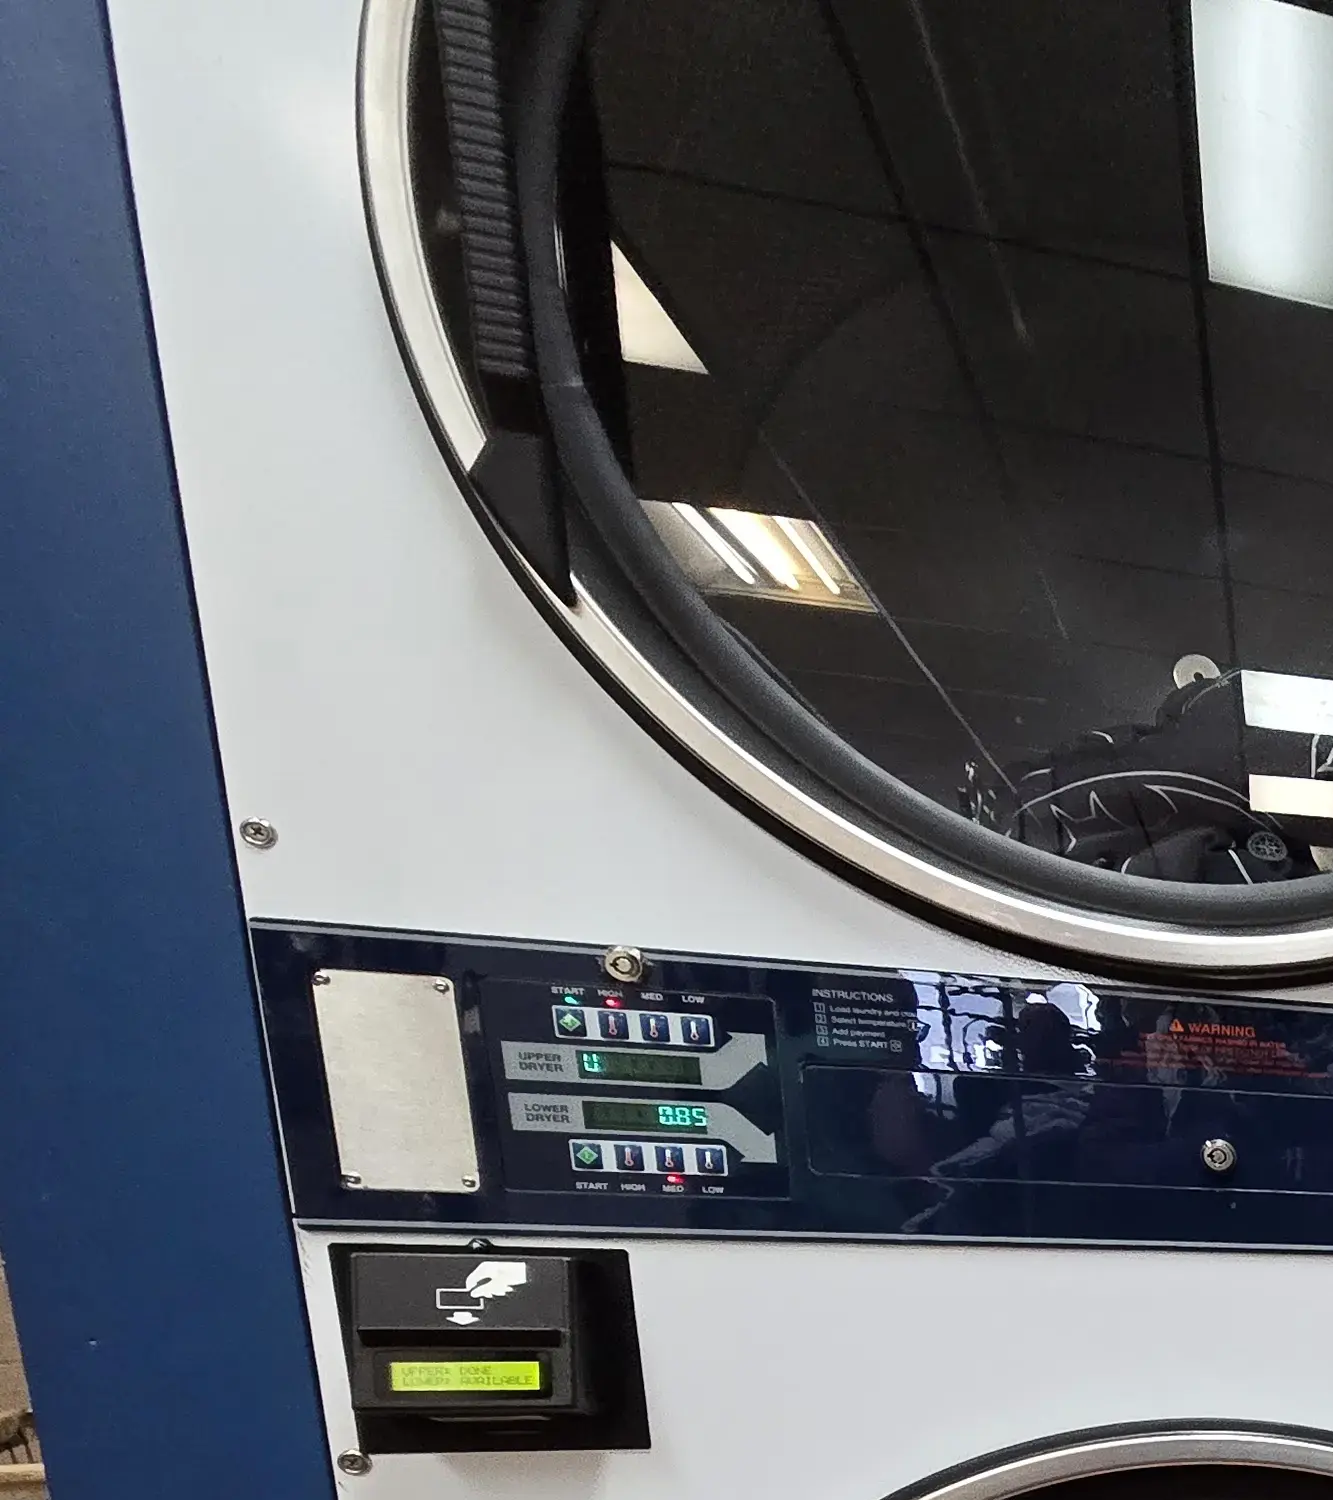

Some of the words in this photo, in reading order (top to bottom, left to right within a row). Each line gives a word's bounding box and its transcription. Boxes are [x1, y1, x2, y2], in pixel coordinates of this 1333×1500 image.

[551, 986, 585, 996] START
[812, 988, 894, 1003] INSTRUCTIONS
[640, 992, 664, 1002] MED
[681, 995, 705, 1004] LOW
[1188, 1022, 1257, 1038] WARNING
[859, 1040, 888, 1049] START
[518, 1052, 562, 1063] UPPER
[518, 1061, 565, 1073] DRYER
[524, 1103, 569, 1114] LOWER
[526, 1113, 570, 1124] DRYER
[575, 1181, 608, 1191] START
[662, 1185, 685, 1193] MED
[460, 1376, 533, 1386] AVAILABLE
